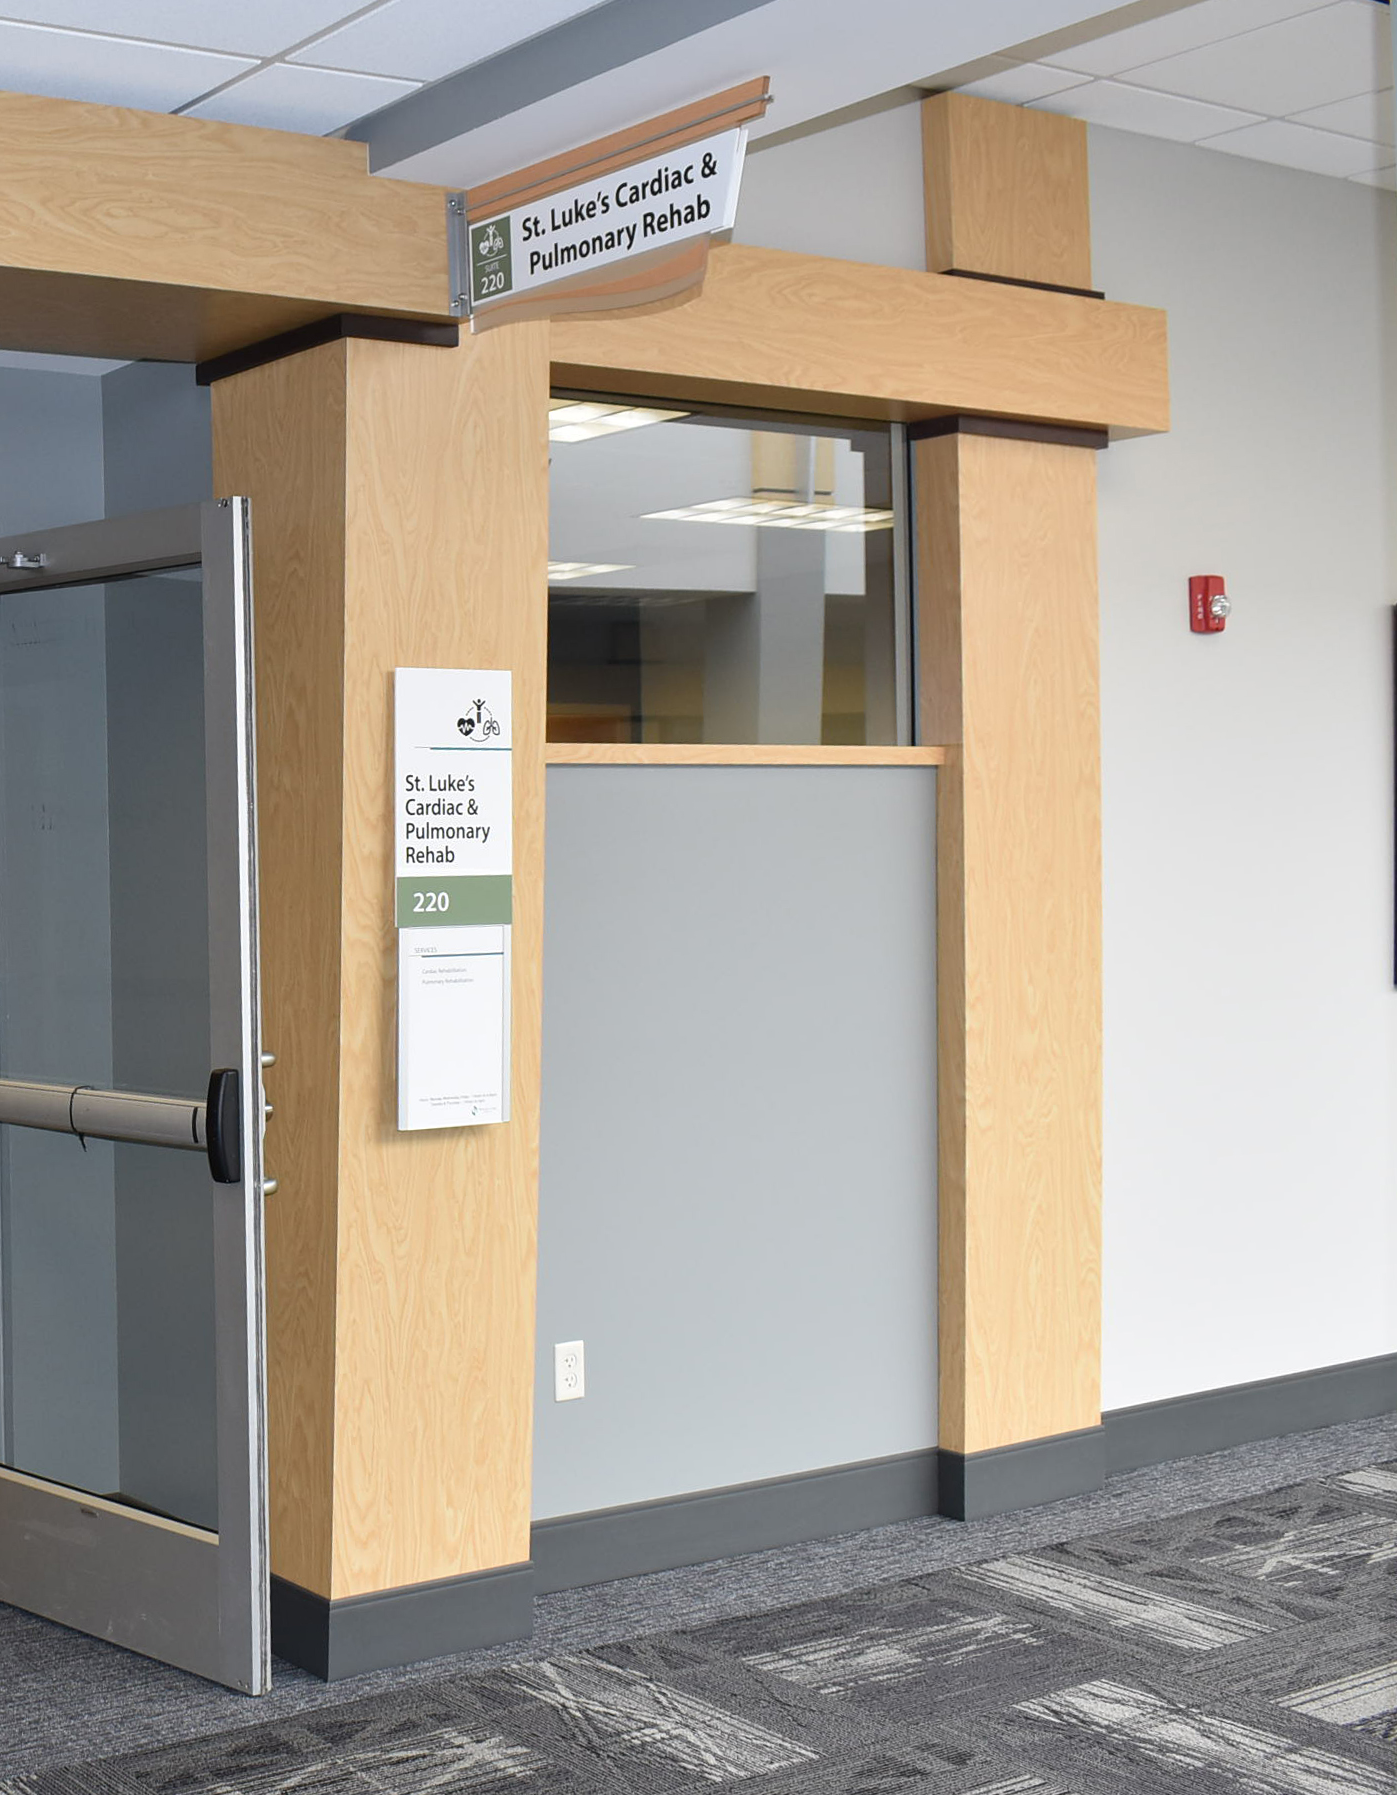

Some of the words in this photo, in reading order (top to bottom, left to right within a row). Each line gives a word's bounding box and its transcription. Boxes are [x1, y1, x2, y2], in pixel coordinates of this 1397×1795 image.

[522, 216, 546, 242] St.
[551, 190, 610, 231] Luke's
[615, 162, 694, 208] Cardiac
[700, 152, 717, 177] &
[529, 224, 637, 275] Pulmonary
[642, 193, 711, 237] Rehab
[481, 272, 504, 295] 220
[405, 774, 425, 792] St.
[429, 774, 475, 792] Luke's
[405, 798, 463, 816] Cardiac
[467, 798, 479, 816] &
[405, 822, 491, 843] Pulmonary
[405, 846, 455, 864] Rehab
[412, 892, 450, 913] 220
